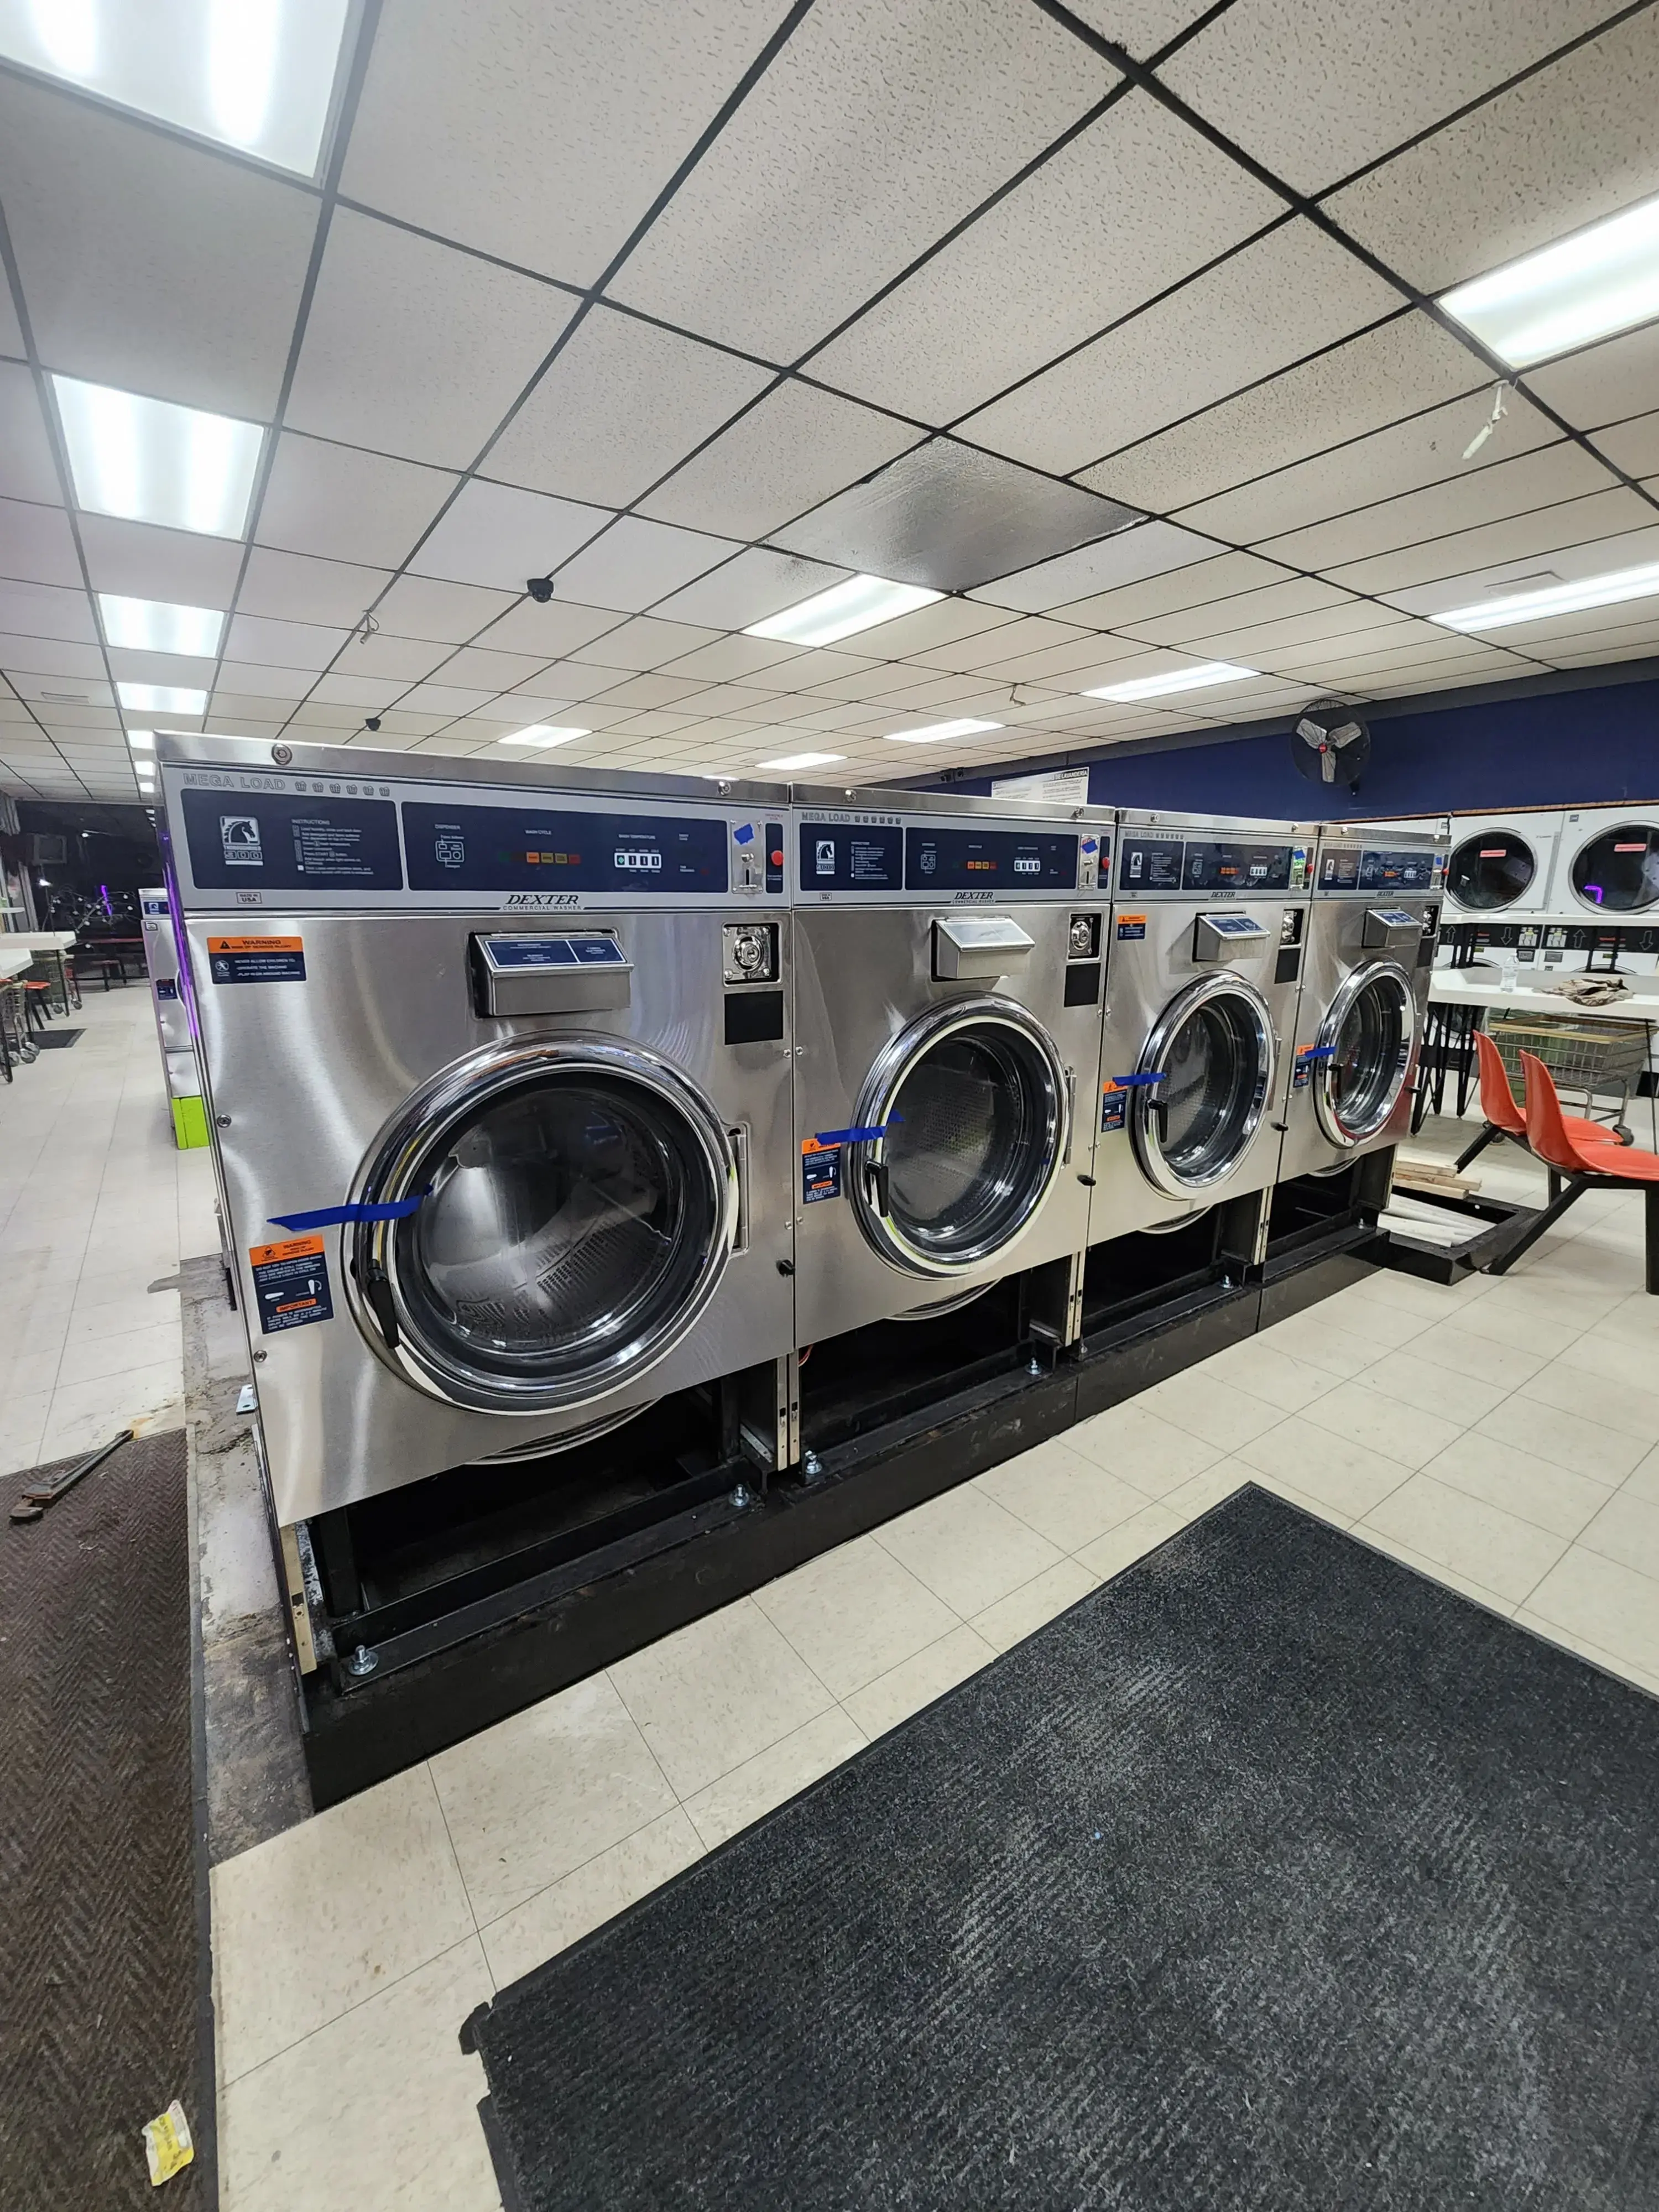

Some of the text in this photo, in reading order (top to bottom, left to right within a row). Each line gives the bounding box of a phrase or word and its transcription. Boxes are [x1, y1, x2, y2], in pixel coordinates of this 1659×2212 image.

[182, 773, 286, 790] MEGA LOAD
[801, 811, 851, 822] MEGA LOAD
[505, 894, 579, 905] DEXTER
[283, 1240, 311, 1249] WARNING
[279, 1300, 313, 1311] IMPORTANT
